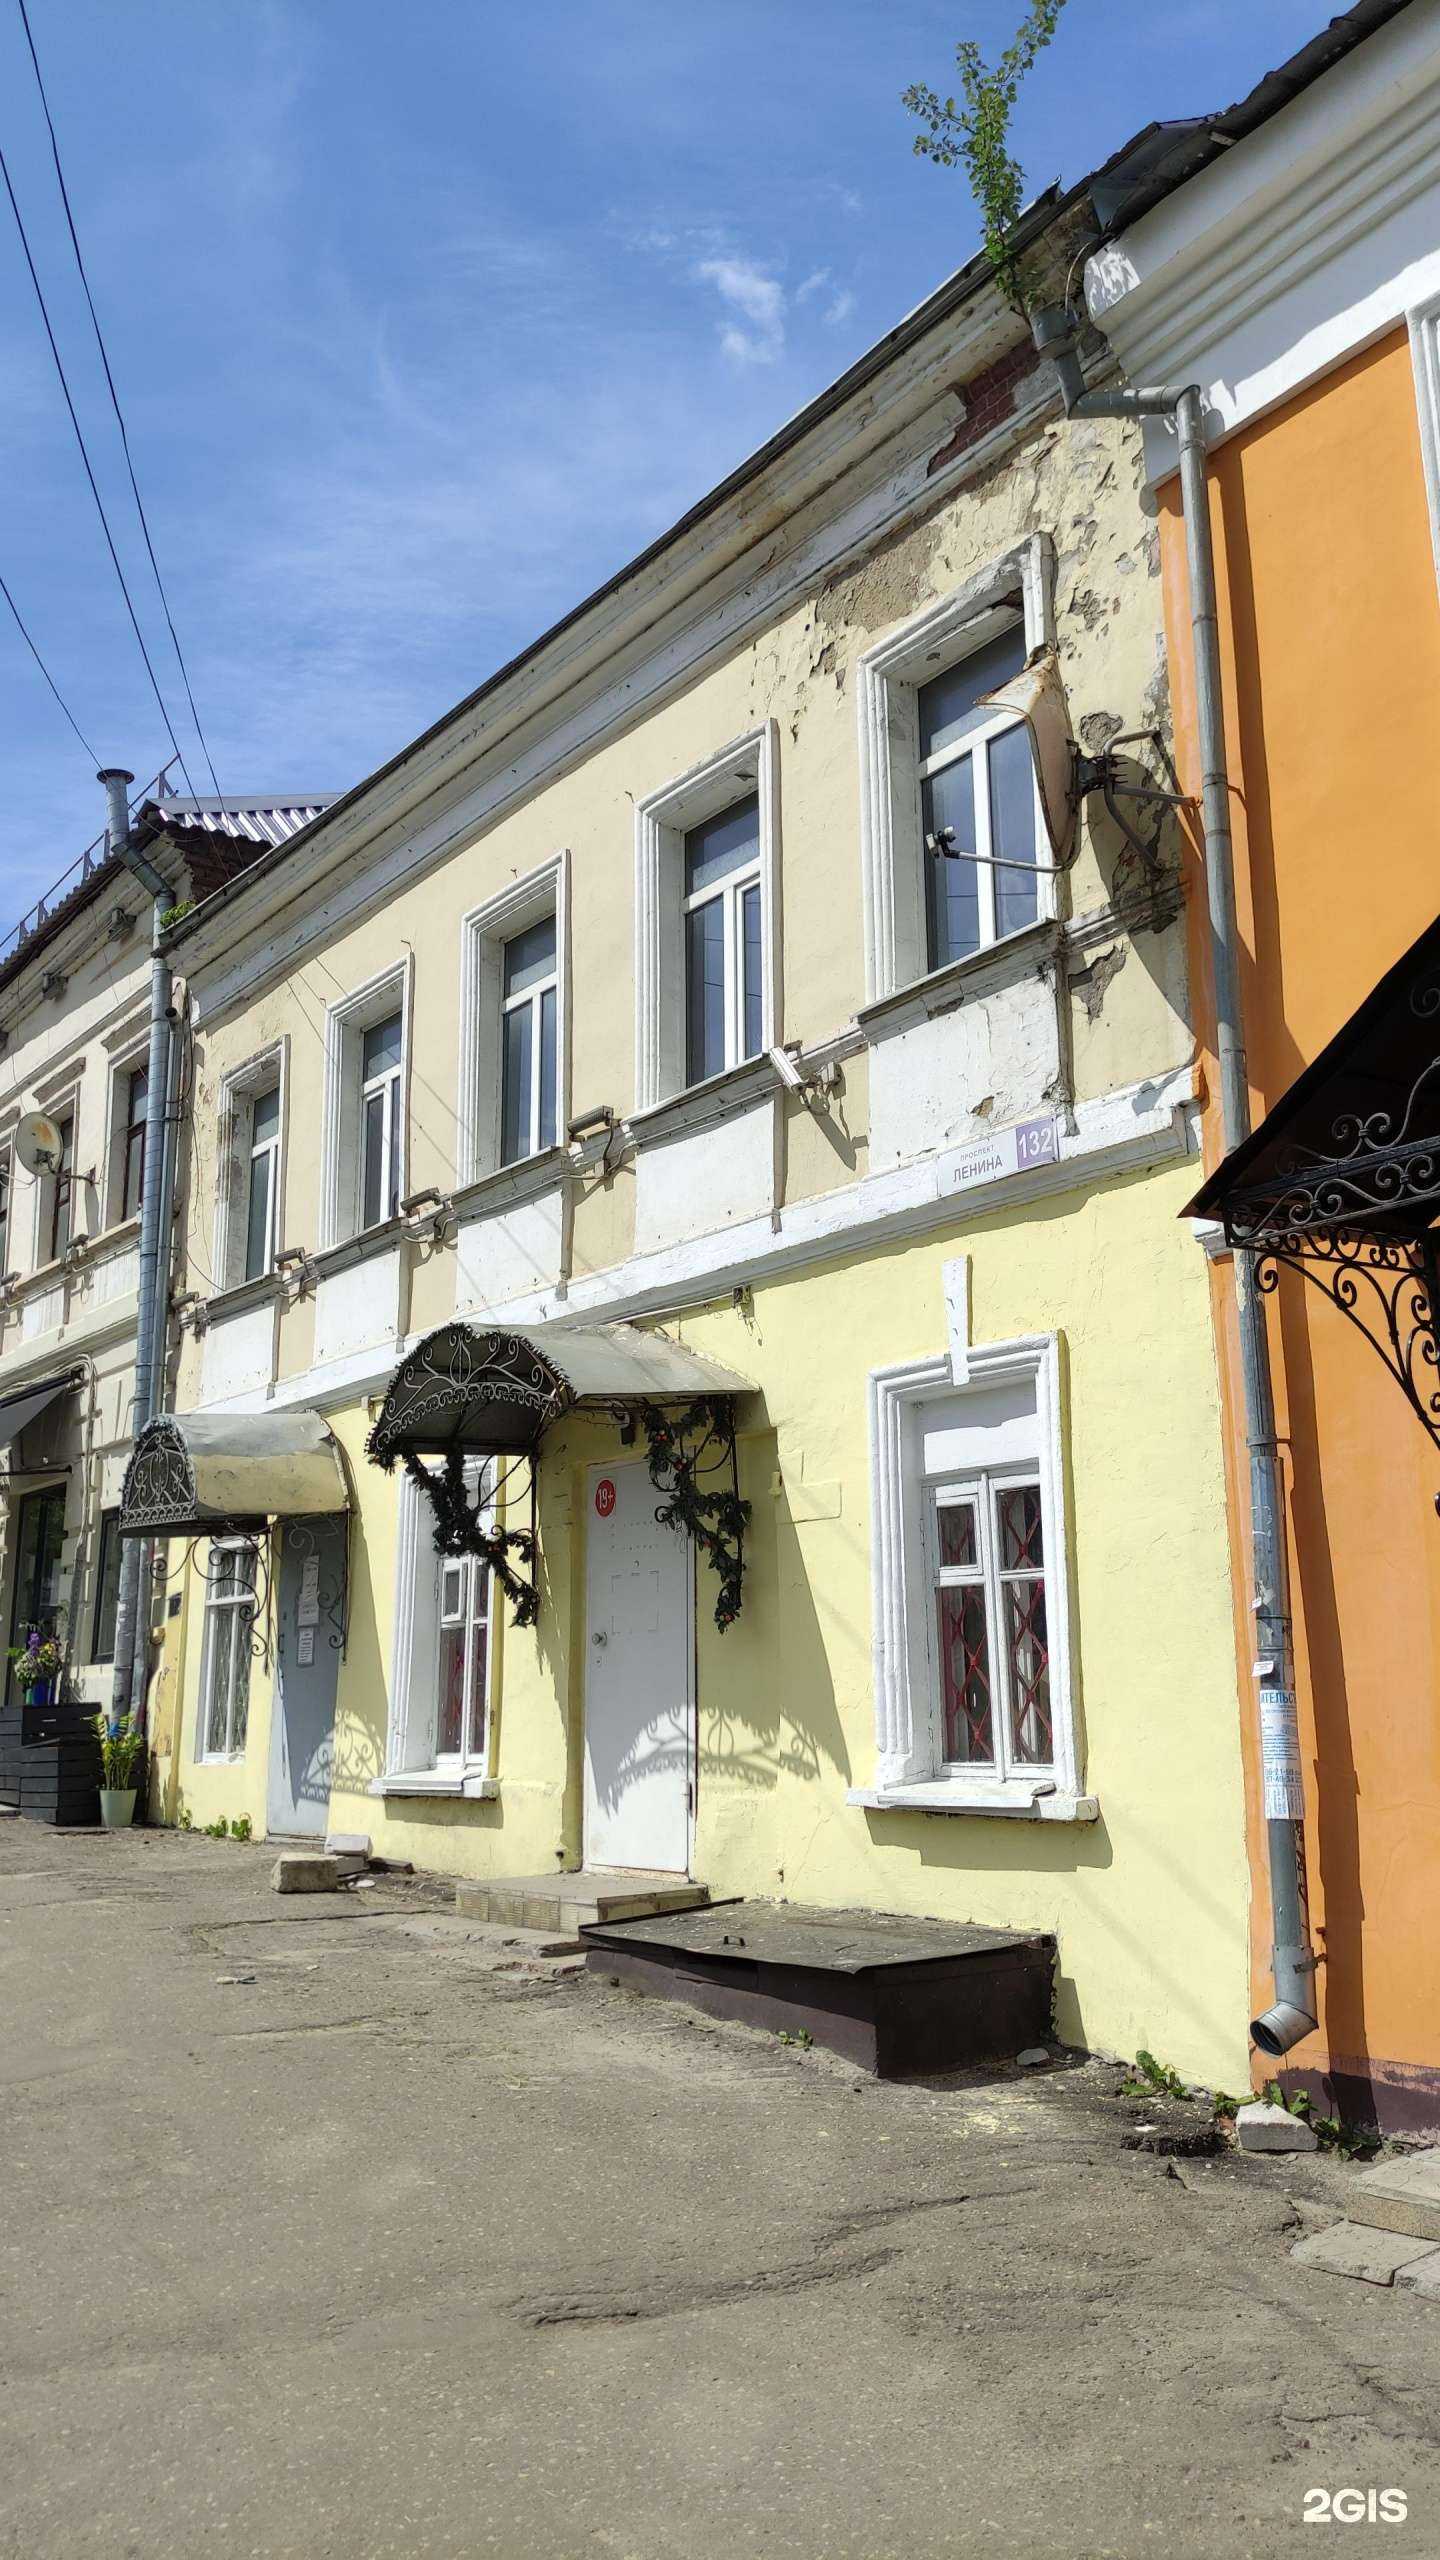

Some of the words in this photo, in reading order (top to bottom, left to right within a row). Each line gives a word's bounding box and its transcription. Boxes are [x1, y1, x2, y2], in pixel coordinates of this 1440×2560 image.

[960, 1145, 994, 1161] ПРОСПЕКТ
[1019, 1127, 1053, 1159] 132
[953, 1155, 1003, 1182] ЛЕНИНА
